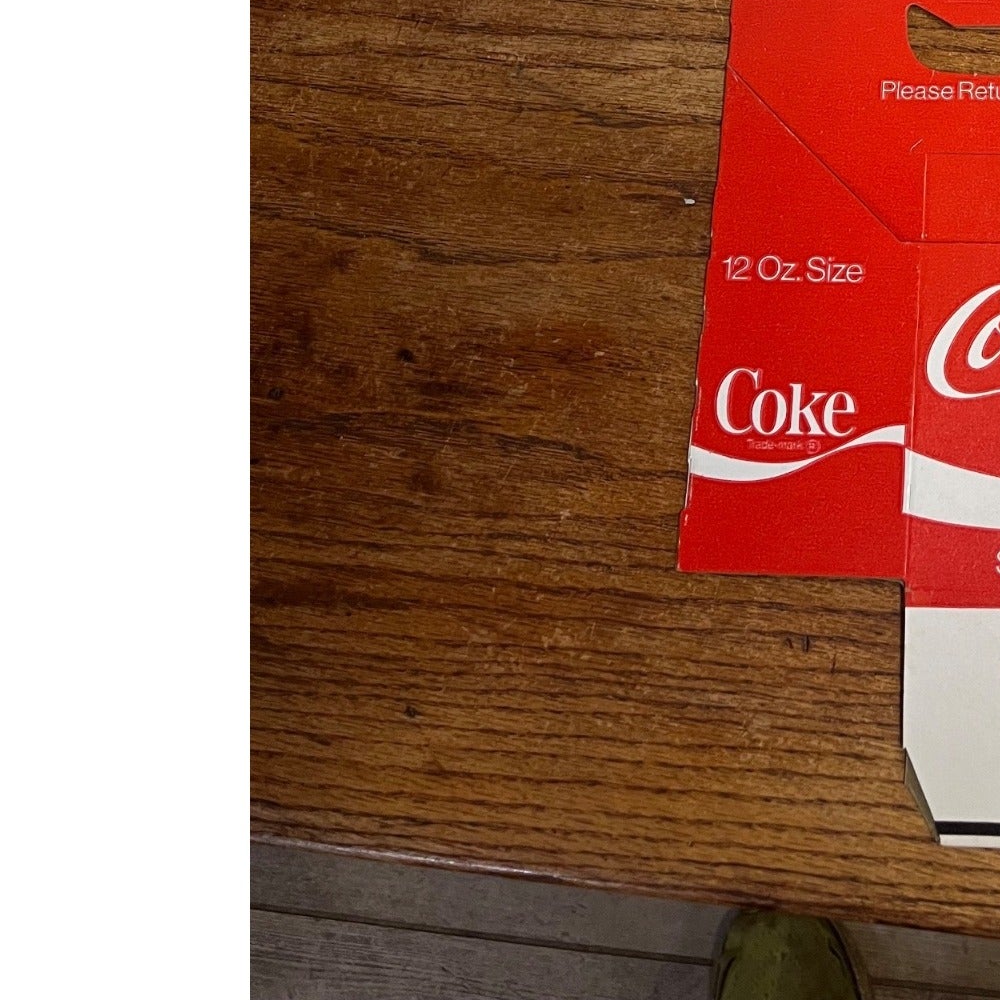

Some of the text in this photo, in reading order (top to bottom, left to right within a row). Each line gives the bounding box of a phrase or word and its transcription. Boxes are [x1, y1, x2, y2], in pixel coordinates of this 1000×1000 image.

[881, 81, 952, 100] Please
[723, 255, 863, 283] 12 Oz. Size
[716, 368, 855, 436] Coke
